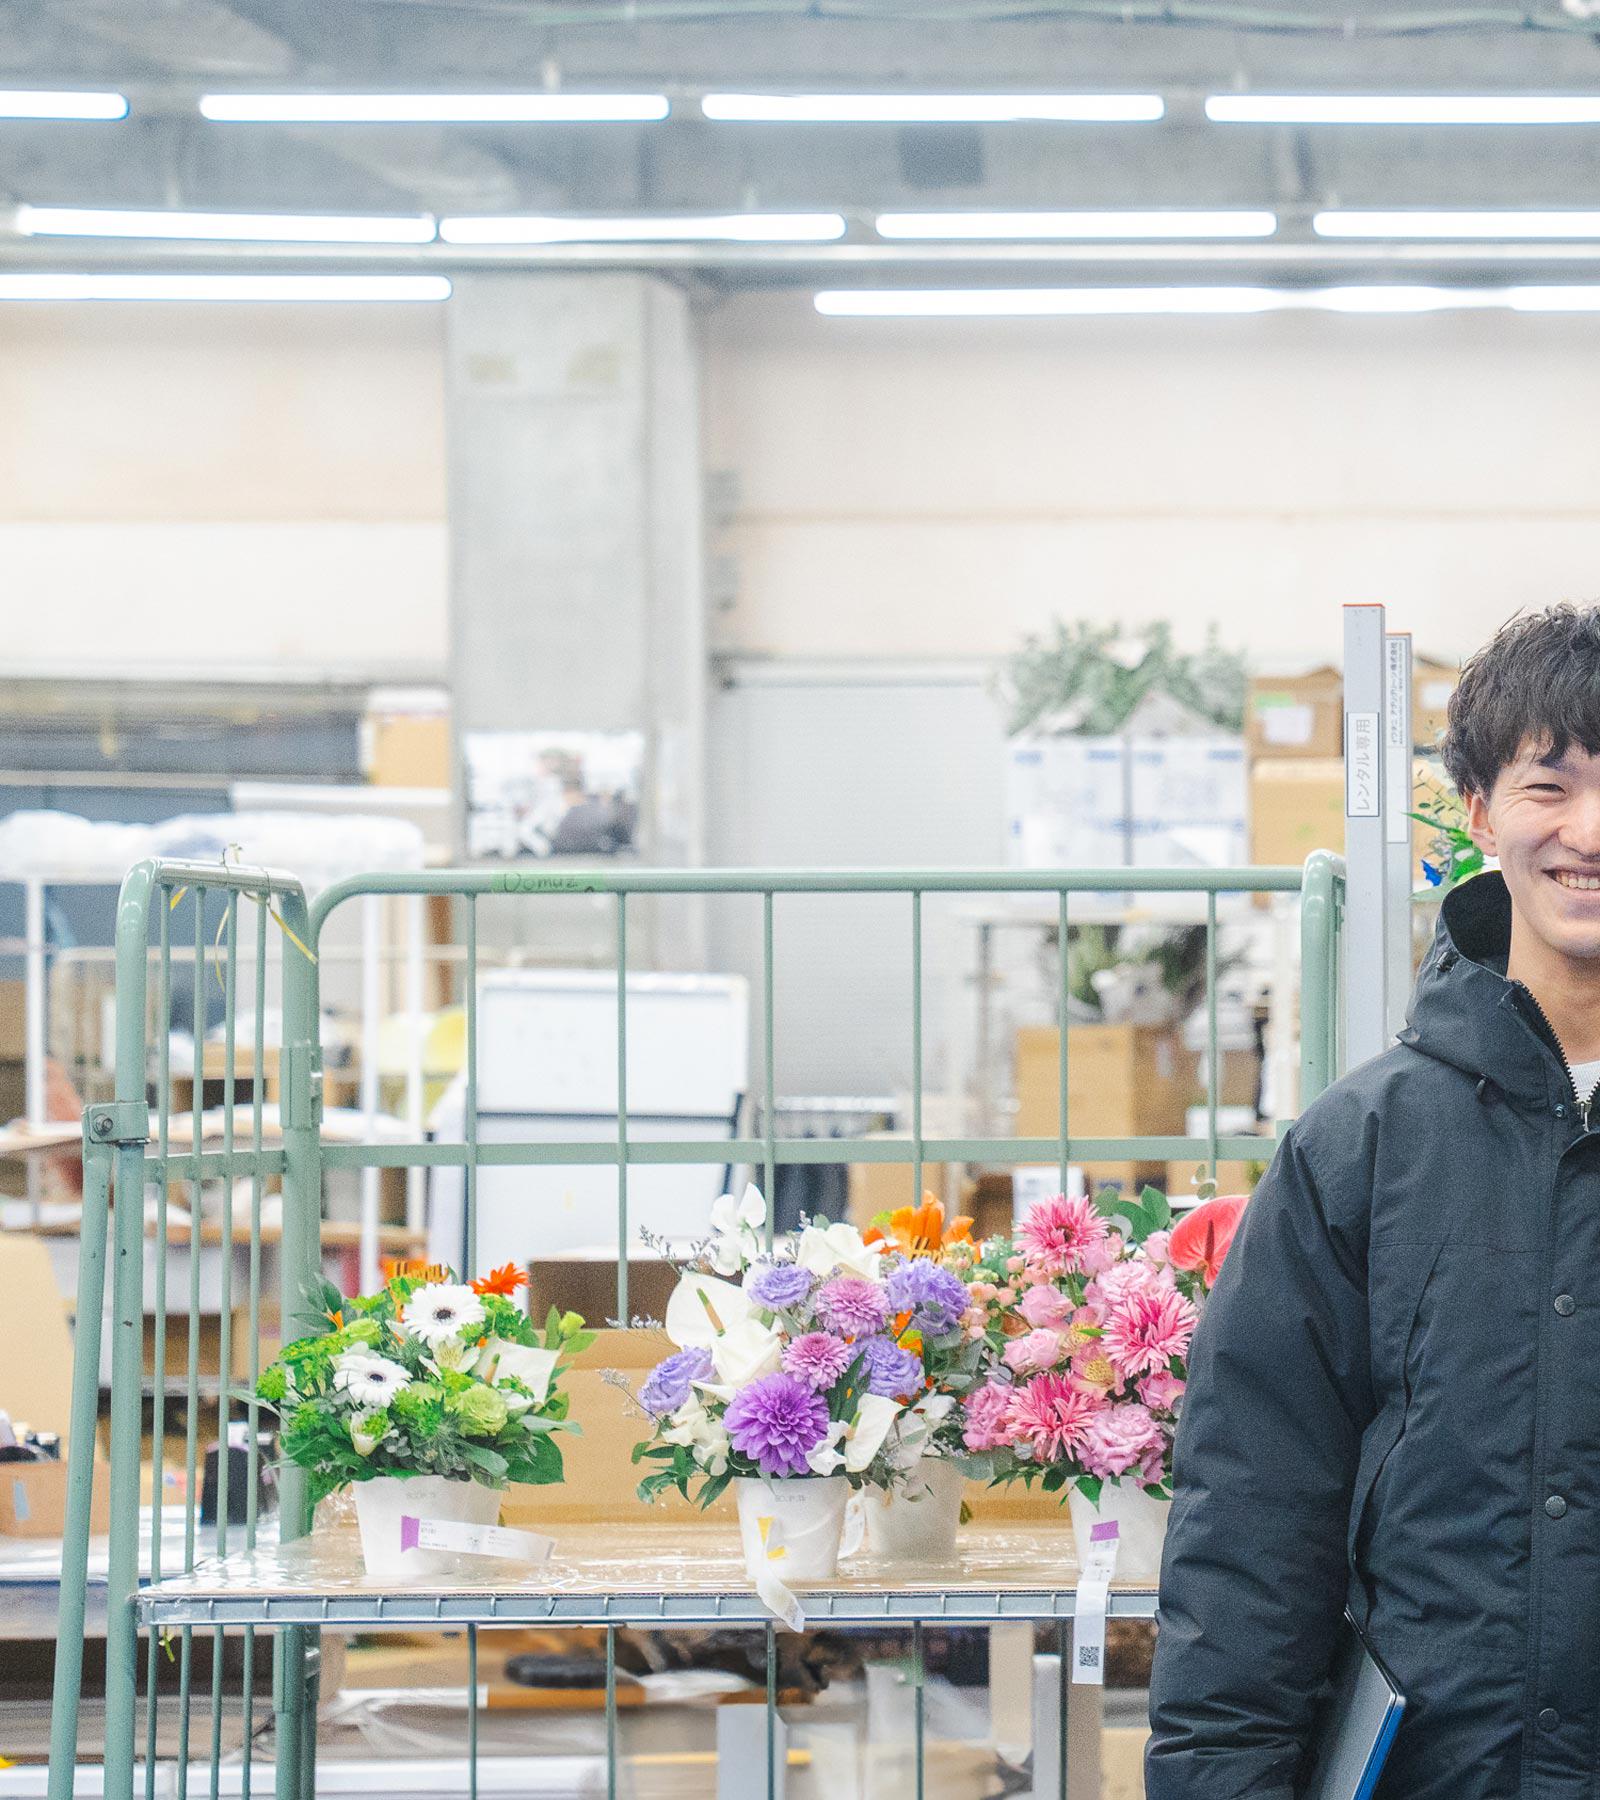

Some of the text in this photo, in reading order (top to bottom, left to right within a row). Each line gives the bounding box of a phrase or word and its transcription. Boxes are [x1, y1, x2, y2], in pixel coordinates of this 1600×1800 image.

[1355, 718, 1371, 811] レンタル専用
